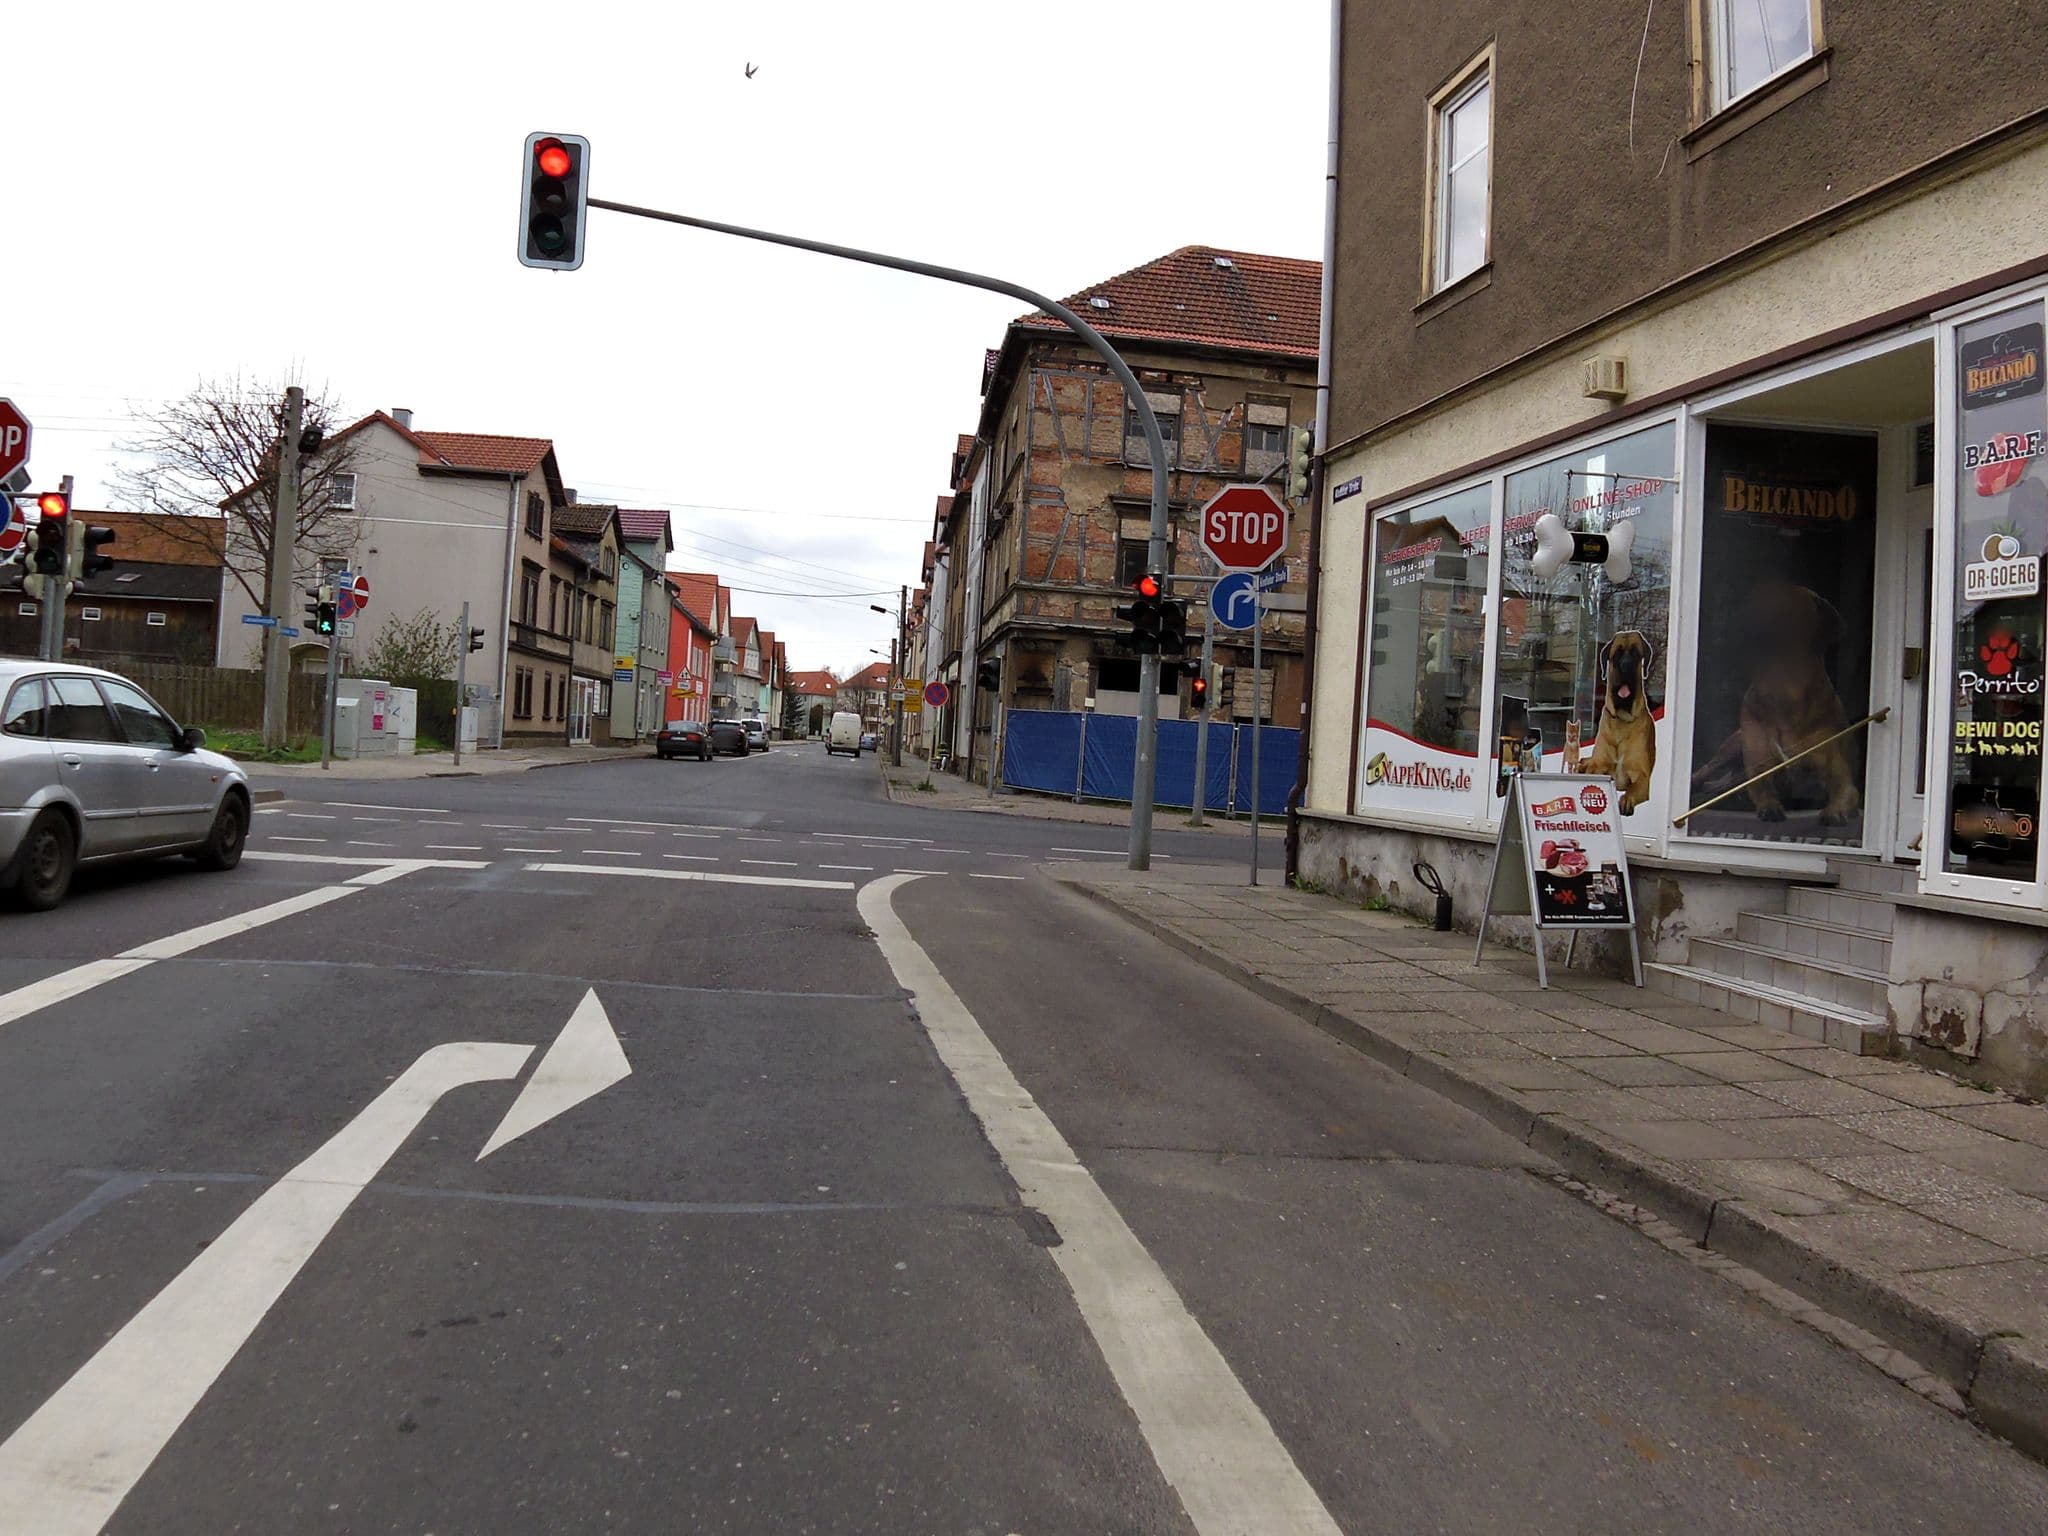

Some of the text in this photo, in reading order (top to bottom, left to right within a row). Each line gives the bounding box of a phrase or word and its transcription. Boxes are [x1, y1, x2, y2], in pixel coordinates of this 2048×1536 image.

[1967, 351, 2037, 394] BELCANDO
[1964, 430, 2045, 469] B.A.R.F.
[1572, 479, 1664, 513] ONLINE-SHOP
[1724, 477, 1857, 520] BELCANDO
[1606, 505, 1642, 522] Stunden
[1209, 511, 1279, 545] STOP
[1958, 670, 2040, 696] Perrito
[1955, 721, 2040, 738] BEWI DOG
[1536, 799, 1572, 815] B.A.R.F.
[1582, 799, 1605, 808] NEU
[1534, 820, 1611, 833] Frischfleisch
